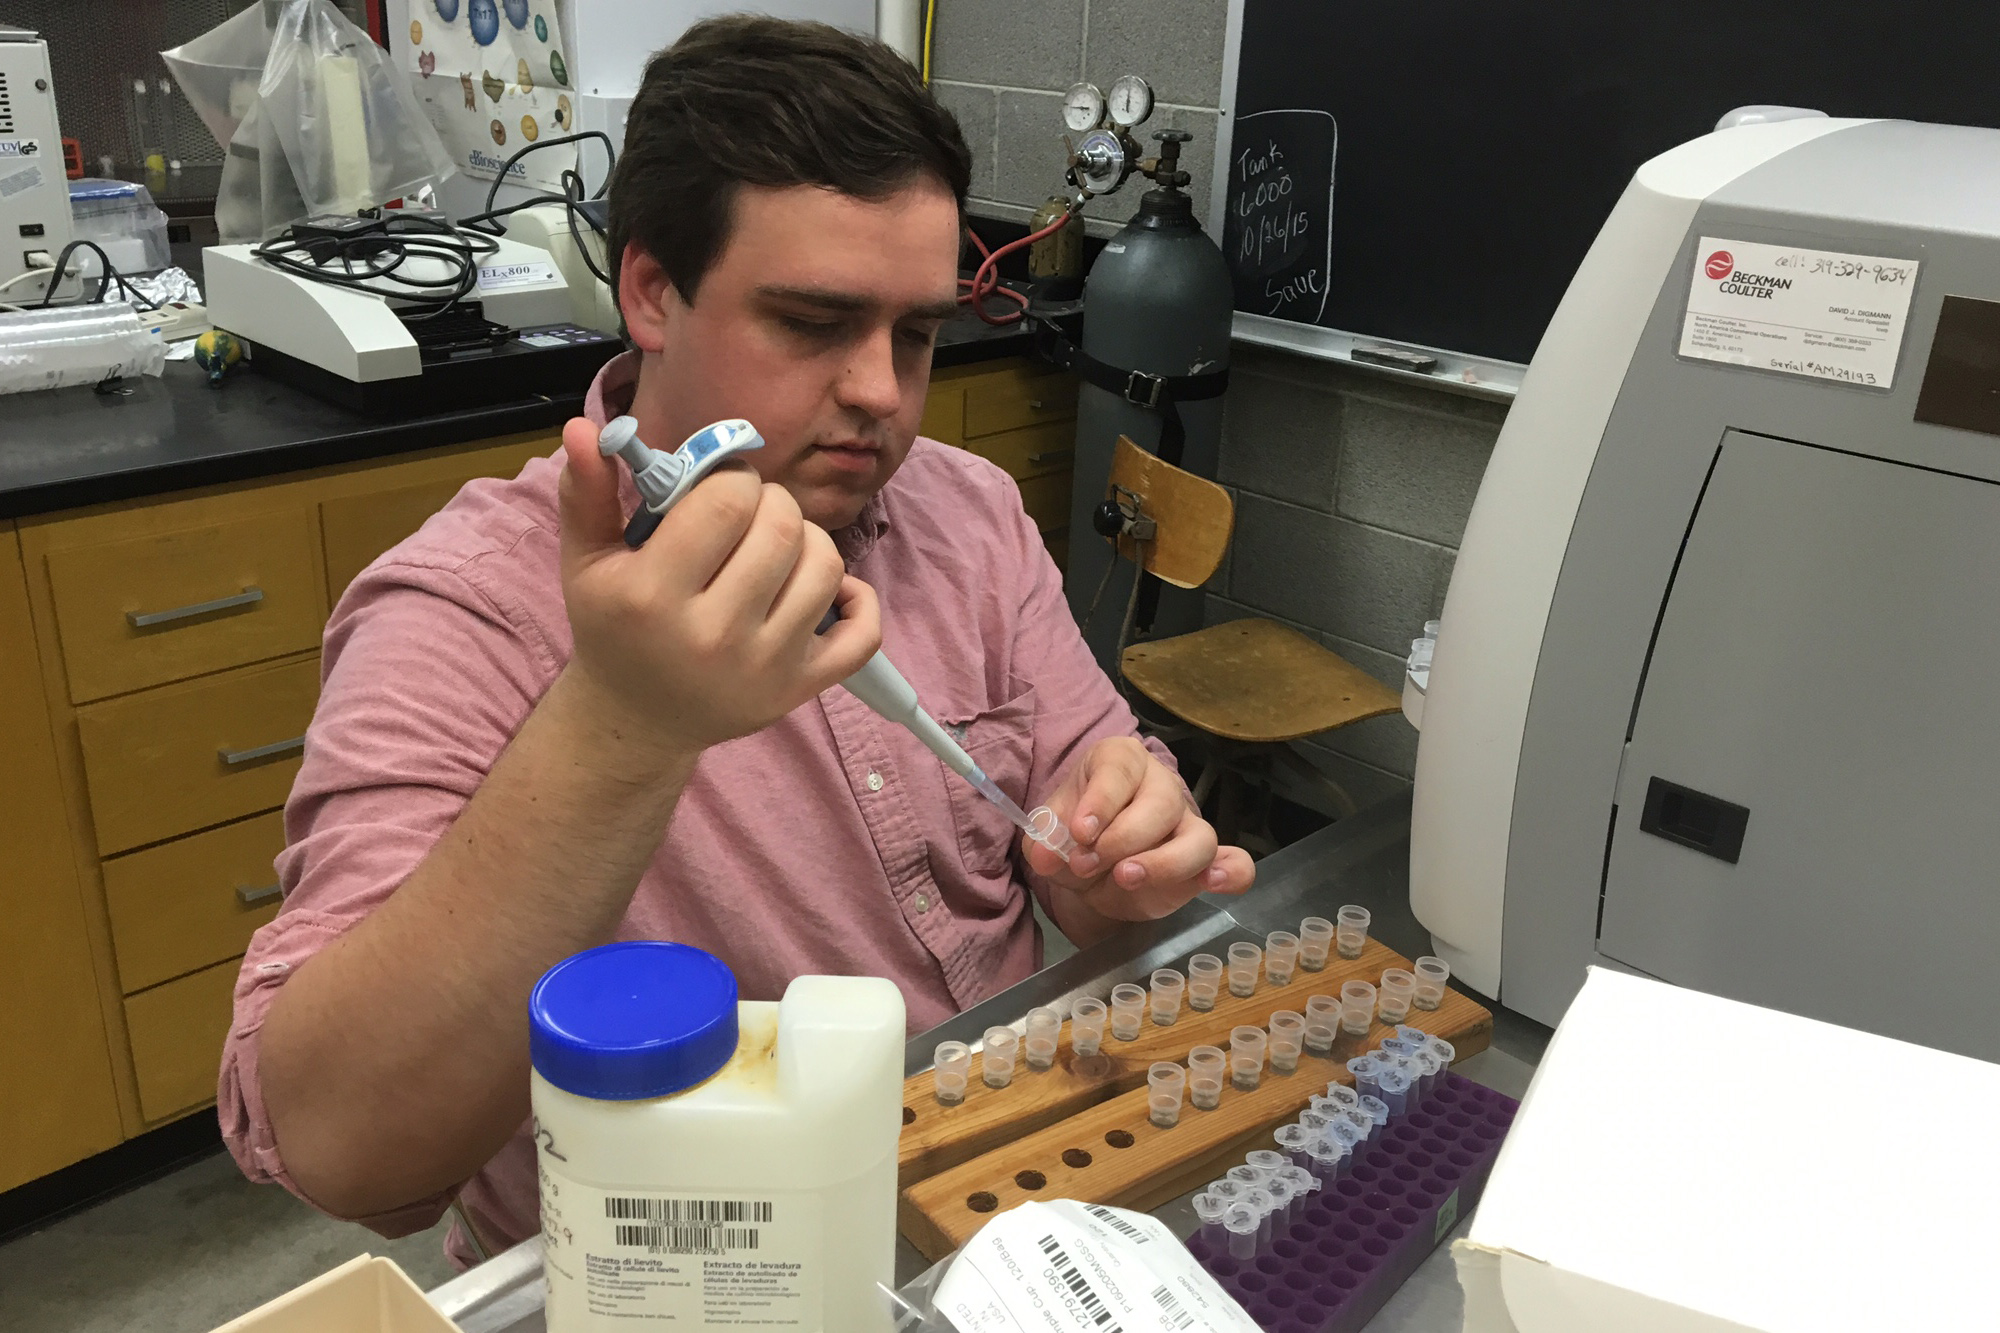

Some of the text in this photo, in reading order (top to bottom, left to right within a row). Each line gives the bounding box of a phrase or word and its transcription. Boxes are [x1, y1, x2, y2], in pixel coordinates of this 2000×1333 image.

[1237, 139, 1284, 182] Tank
[1240, 201, 1308, 266] 10/26/15
[1731, 270, 1793, 290] BECKMAN
[1265, 269, 1324, 315] Save
[1719, 281, 1774, 300] COULTER
[1695, 316, 1717, 324] Beckman
[1828, 306, 1849, 315] DAVID
[1858, 310, 1891, 320] DIGMANN
[1865, 317, 1890, 326] Specialist
[1712, 331, 1733, 339] American
[1730, 327, 1758, 336] Commercial
[1760, 332, 1787, 340] Operations
[1770, 359, 1803, 372] Serial
[1088, 1223, 1108, 1238] 120
[721, 1248, 726, 1256] 5
[586, 1253, 663, 1267] Estratto di lievito
[586, 1261, 613, 1270] Estratto
[703, 1261, 742, 1269] Extracto
[760, 1262, 802, 1270] levadura
[991, 1237, 1025, 1282] 120/Bag
[1073, 1238, 1134, 1314] P160205MGSG
[1043, 1268, 1092, 1330] 12791390
[979, 1310, 991, 1323] IN
[987, 1301, 1006, 1324] USA
